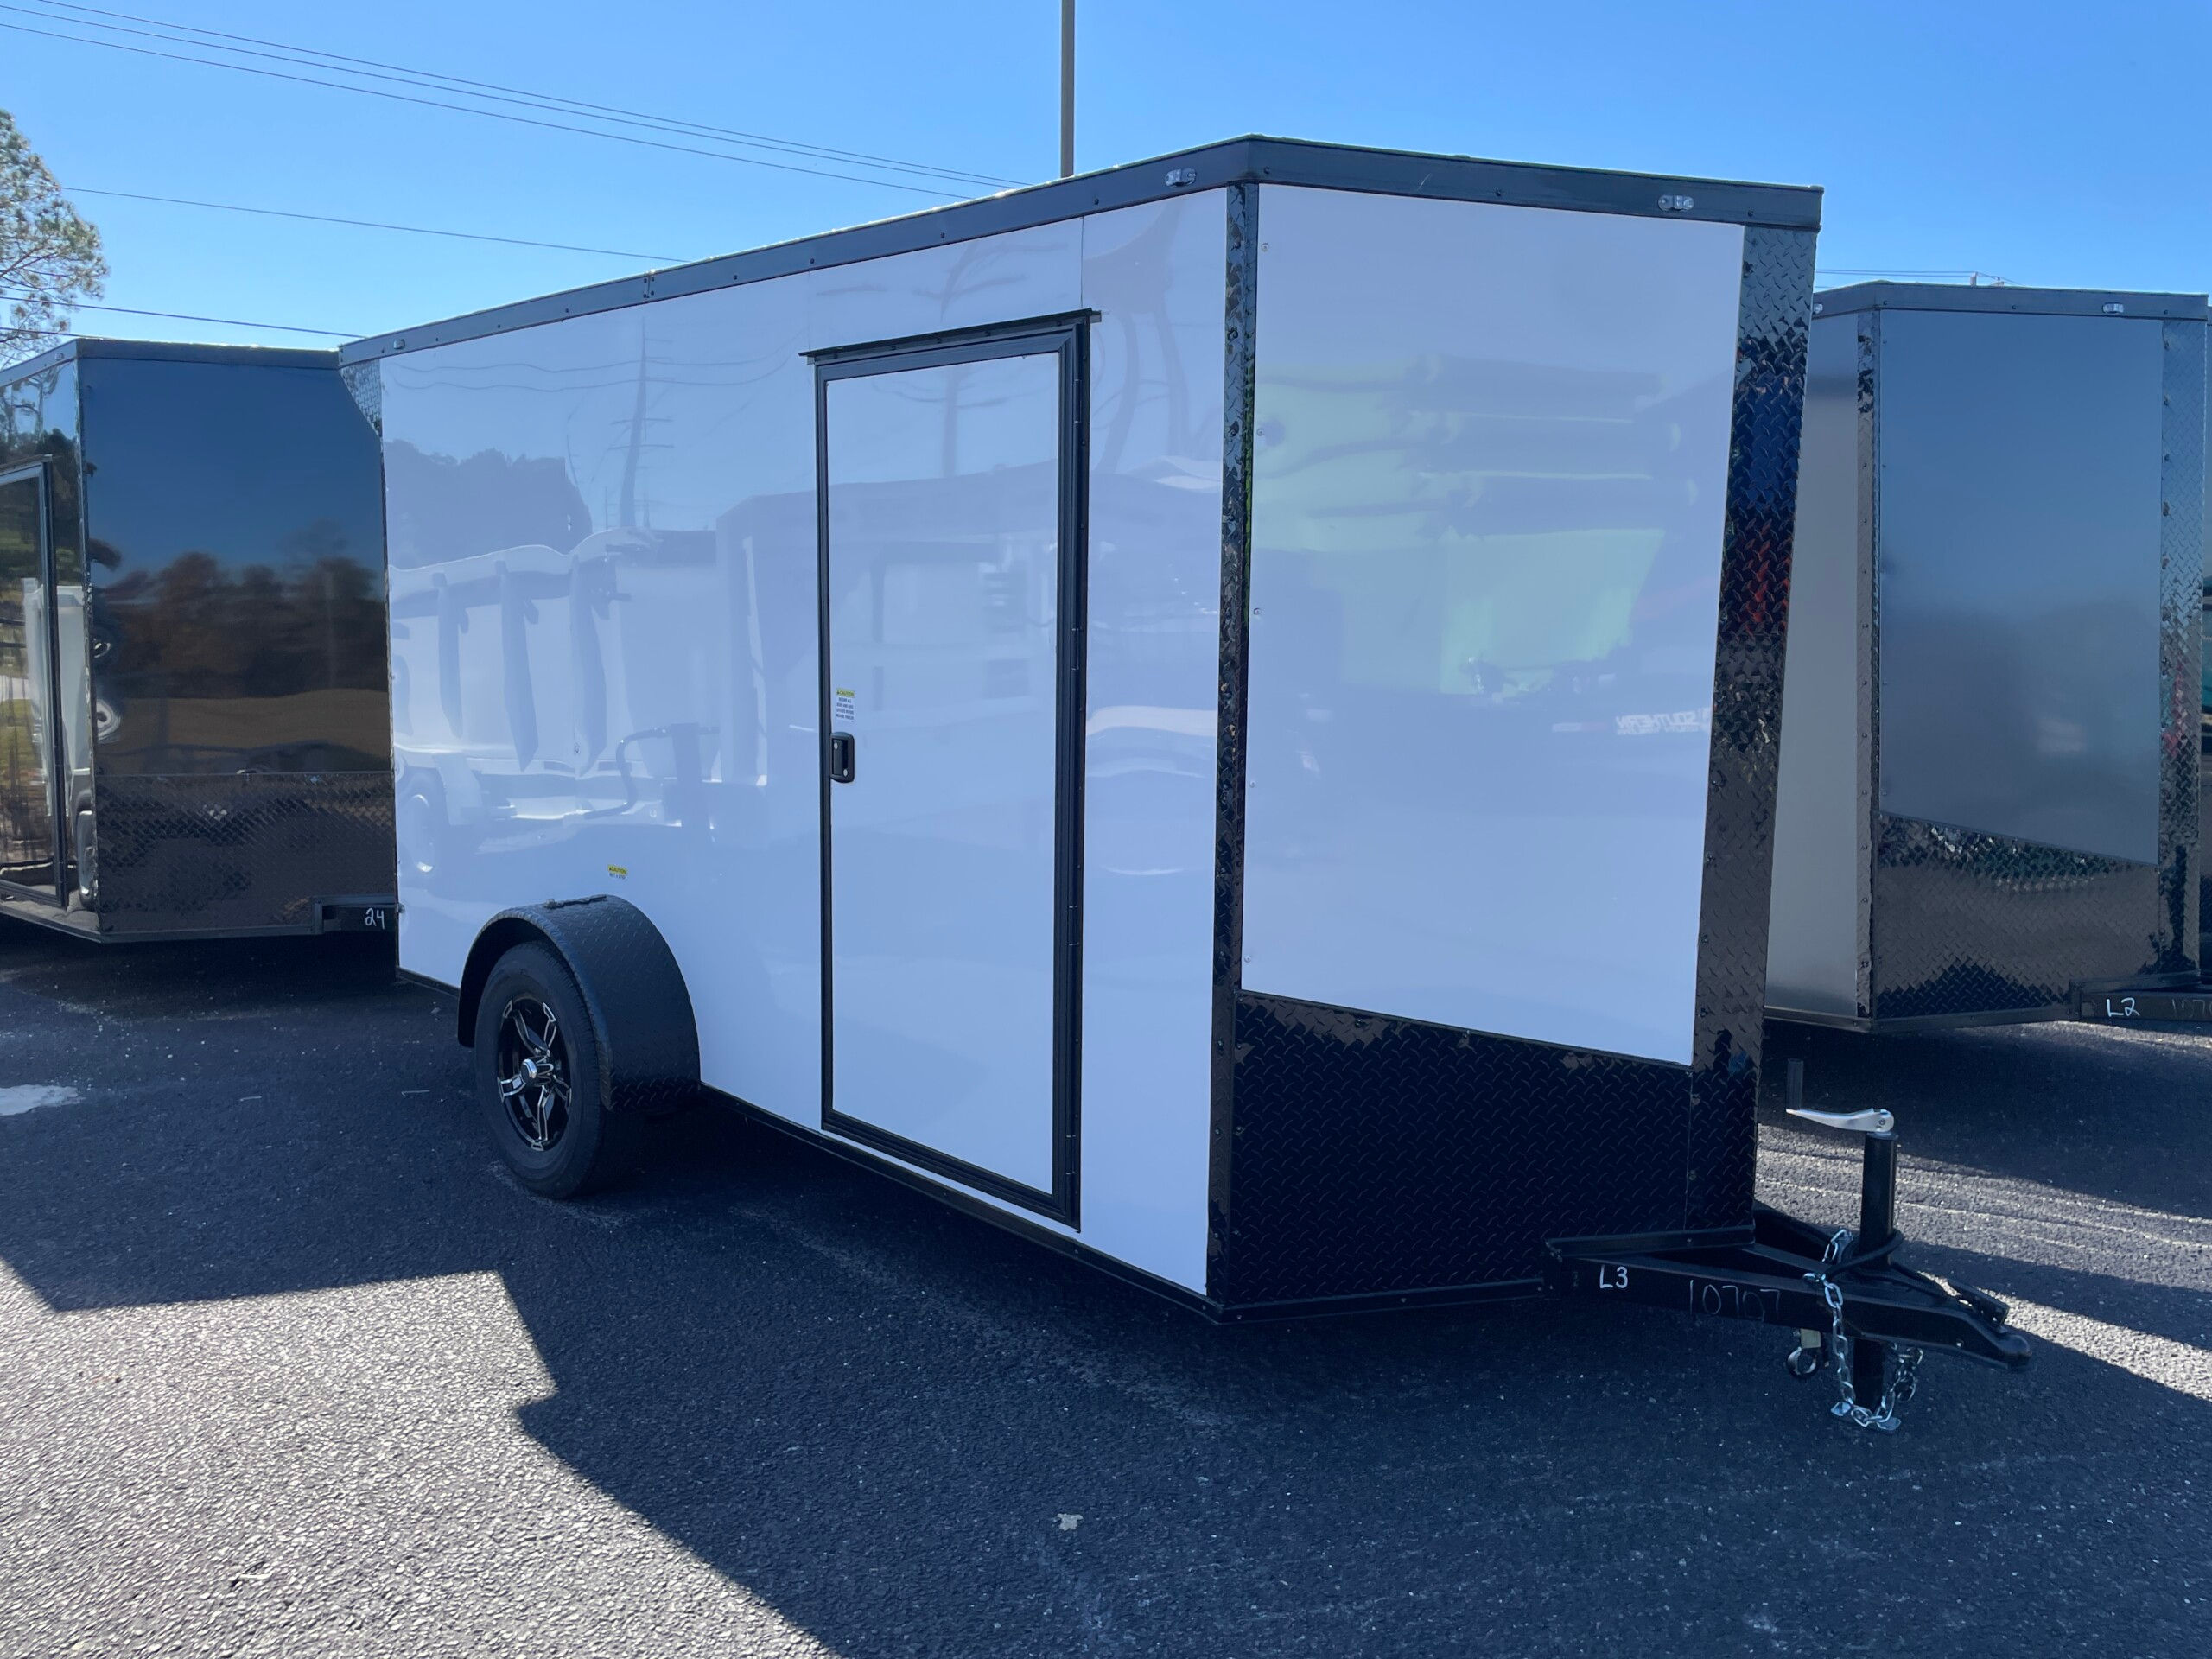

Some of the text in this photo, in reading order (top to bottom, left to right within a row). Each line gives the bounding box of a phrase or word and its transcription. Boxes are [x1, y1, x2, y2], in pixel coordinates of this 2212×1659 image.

[365, 907, 385, 931] 24
[2106, 997, 2140, 1017] L2
[1599, 1264, 1630, 1289] L3
